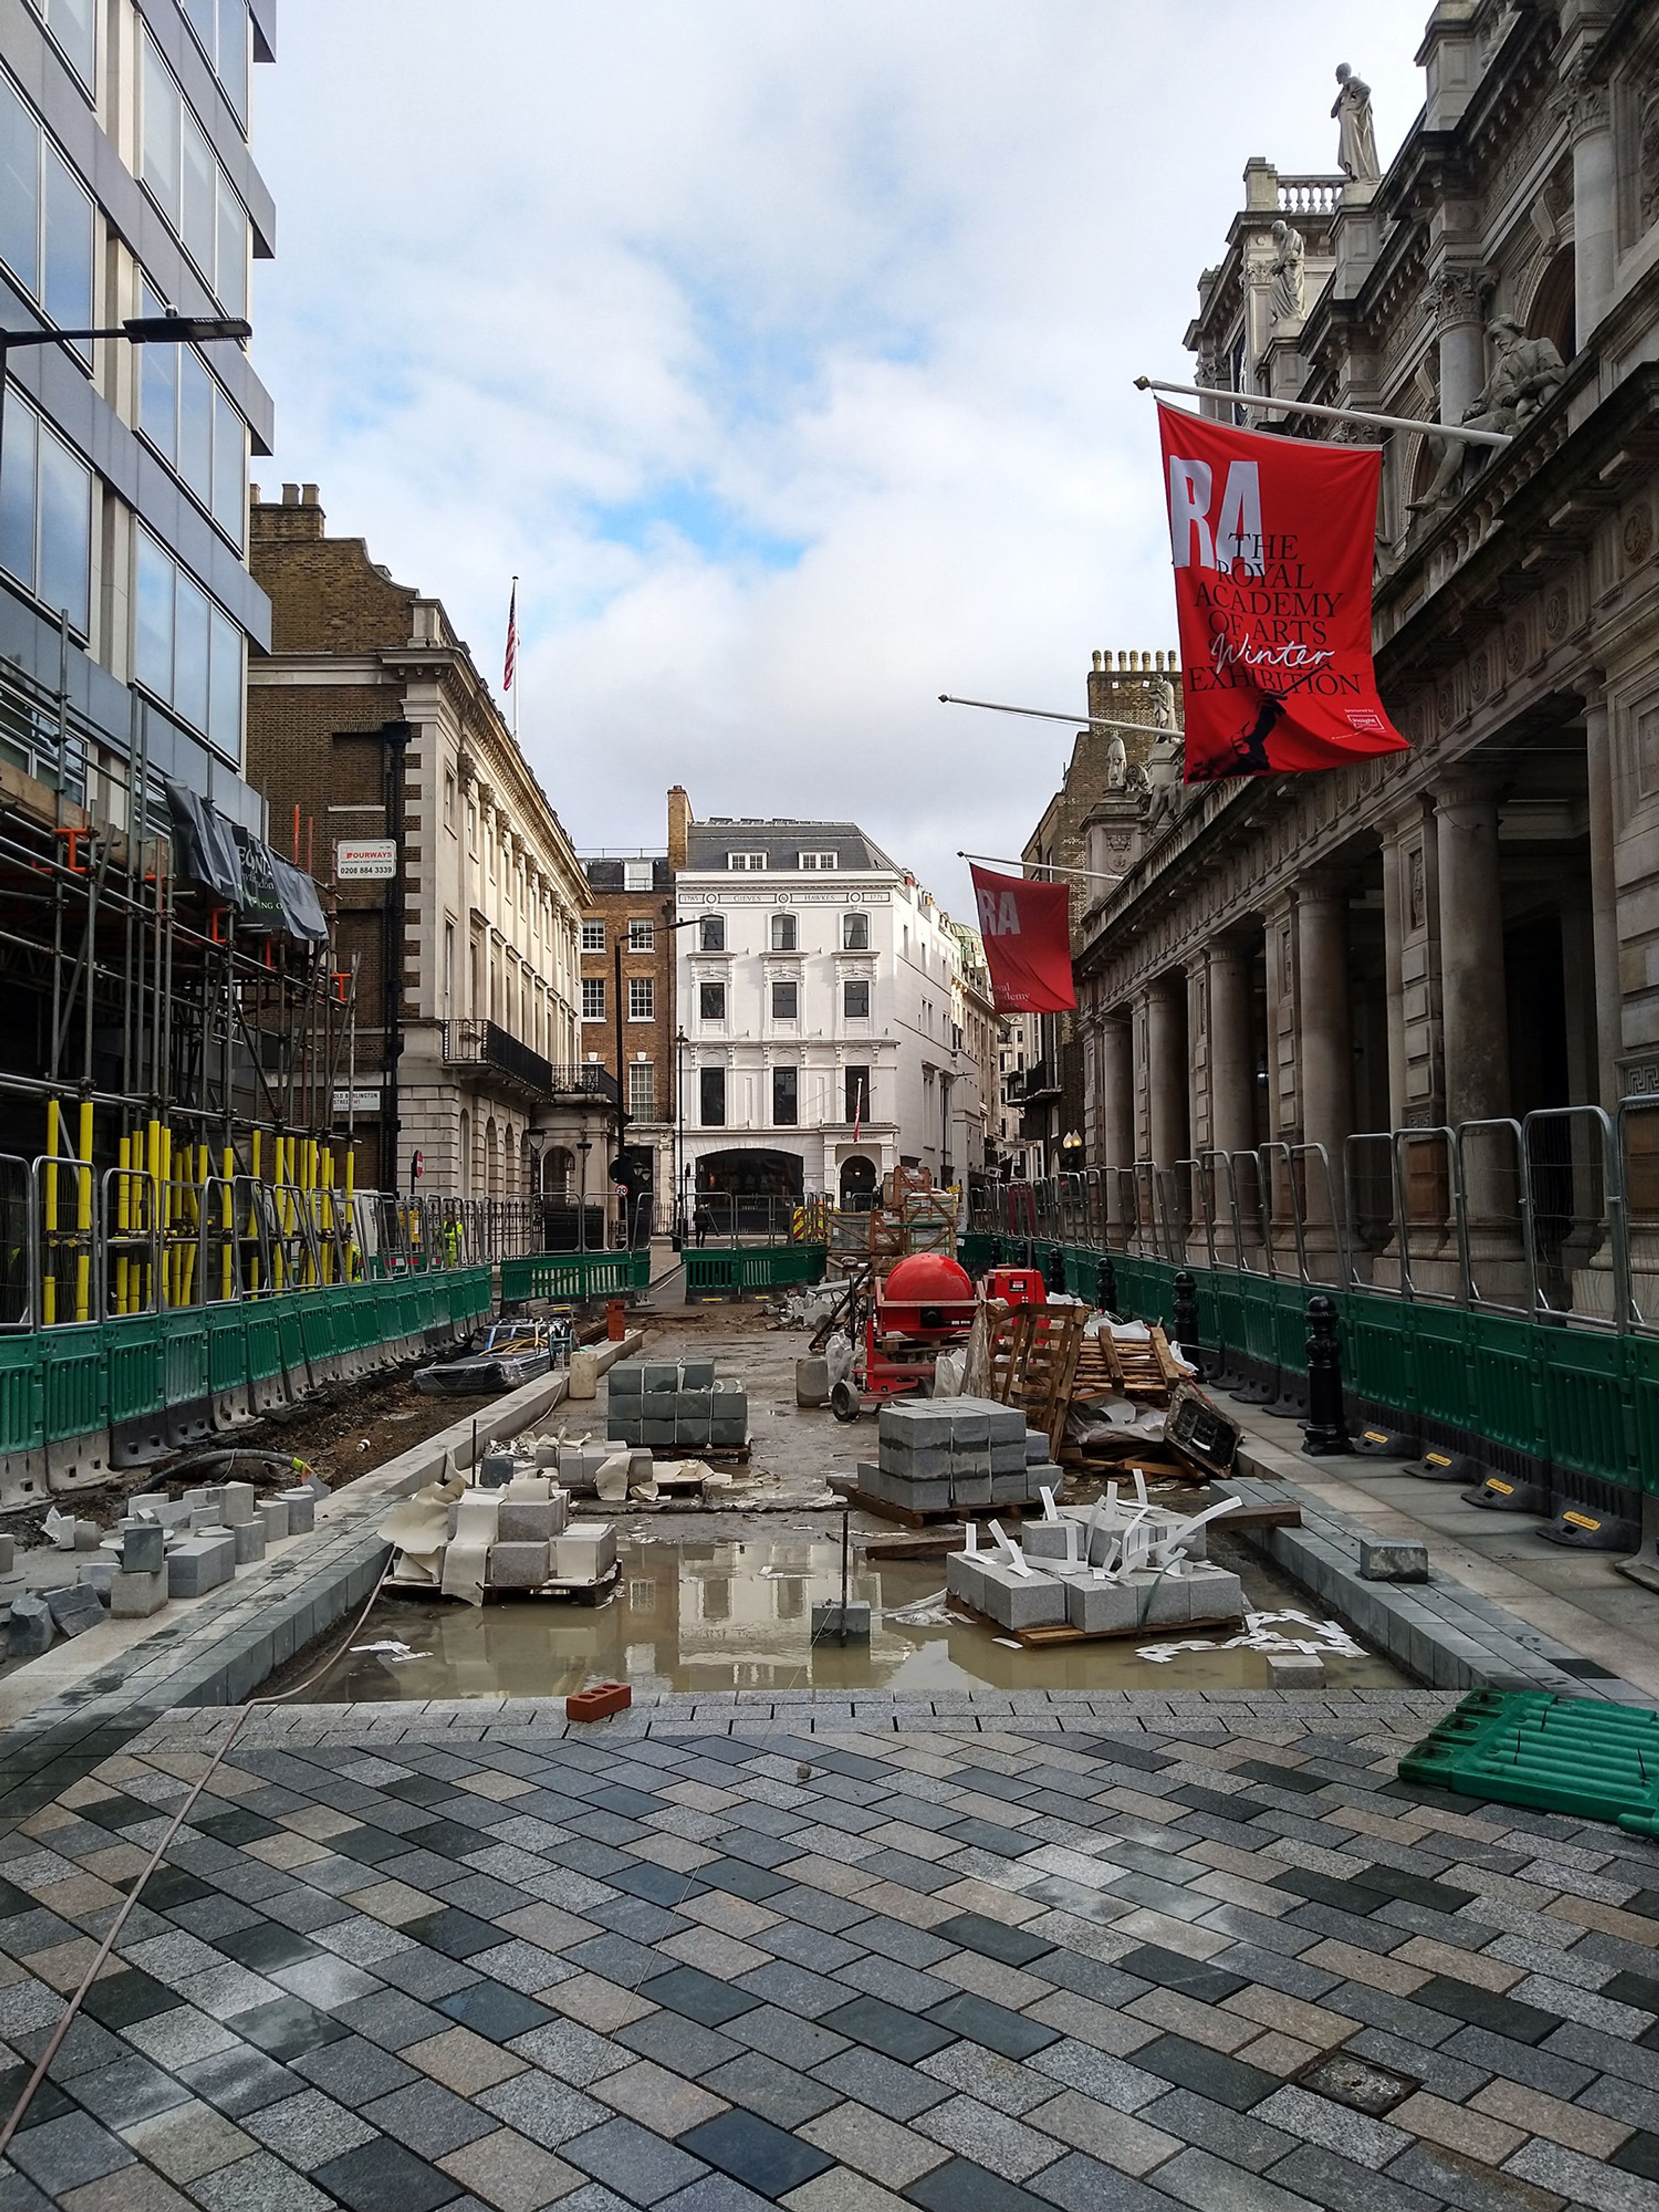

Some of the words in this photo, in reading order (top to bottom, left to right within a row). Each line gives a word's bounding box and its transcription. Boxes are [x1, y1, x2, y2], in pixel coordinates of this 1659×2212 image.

[1169, 454, 1265, 576] RA
[1228, 533, 1298, 560] THE
[1217, 559, 1314, 589] ROYAL
[1194, 581, 1344, 618] ACADEMY
[1208, 610, 1243, 636] OF
[1252, 618, 1327, 645] ARTS
[1211, 632, 1336, 674] Winter
[1188, 665, 1361, 695] EXHIBITION
[977, 888, 1021, 936] RA
